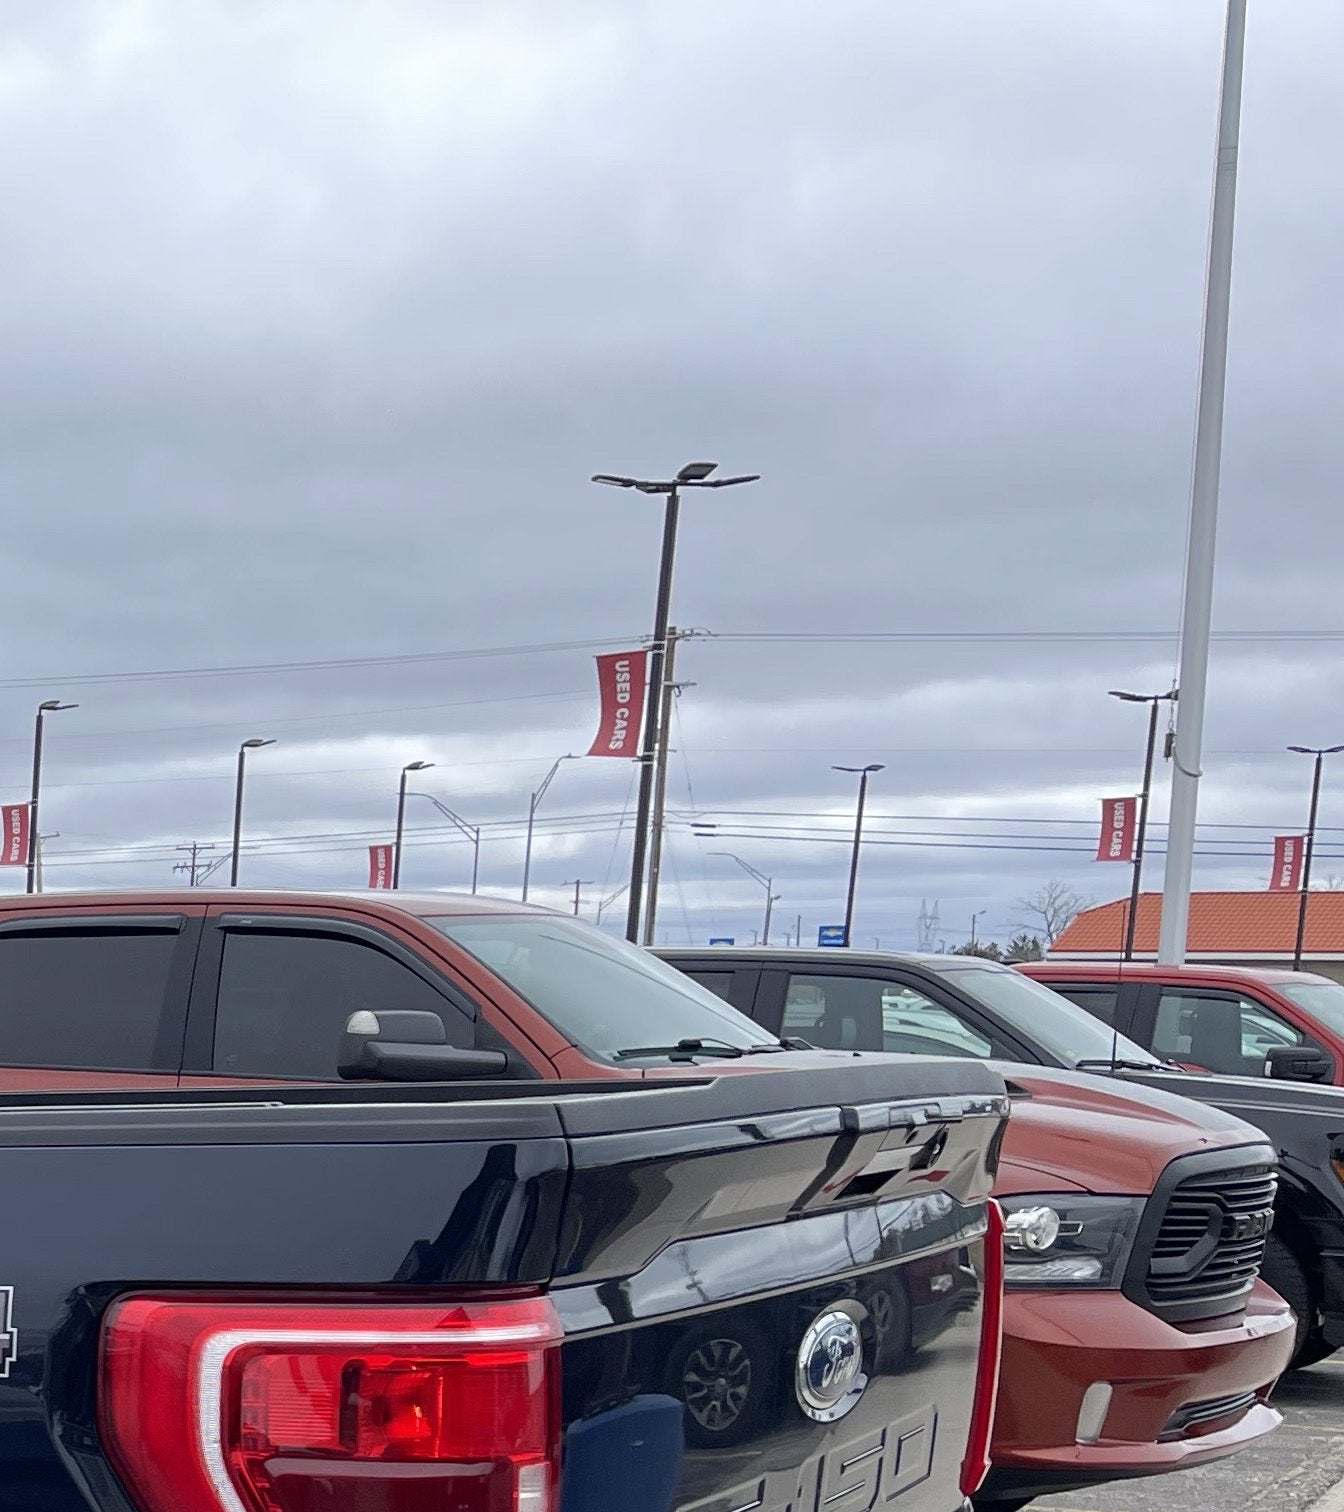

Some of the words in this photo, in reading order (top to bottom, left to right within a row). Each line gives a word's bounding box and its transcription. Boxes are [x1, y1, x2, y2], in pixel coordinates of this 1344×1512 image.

[614, 660, 631, 704] USED
[608, 707, 630, 750] CARS
[11, 809, 21, 834] USED
[1113, 801, 1125, 829] USED
[9, 836, 21, 861] CARS
[1109, 830, 1124, 857] CARS
[1283, 839, 1295, 864] USED
[377, 847, 386, 869] USED
[1279, 863, 1293, 888] CARS
